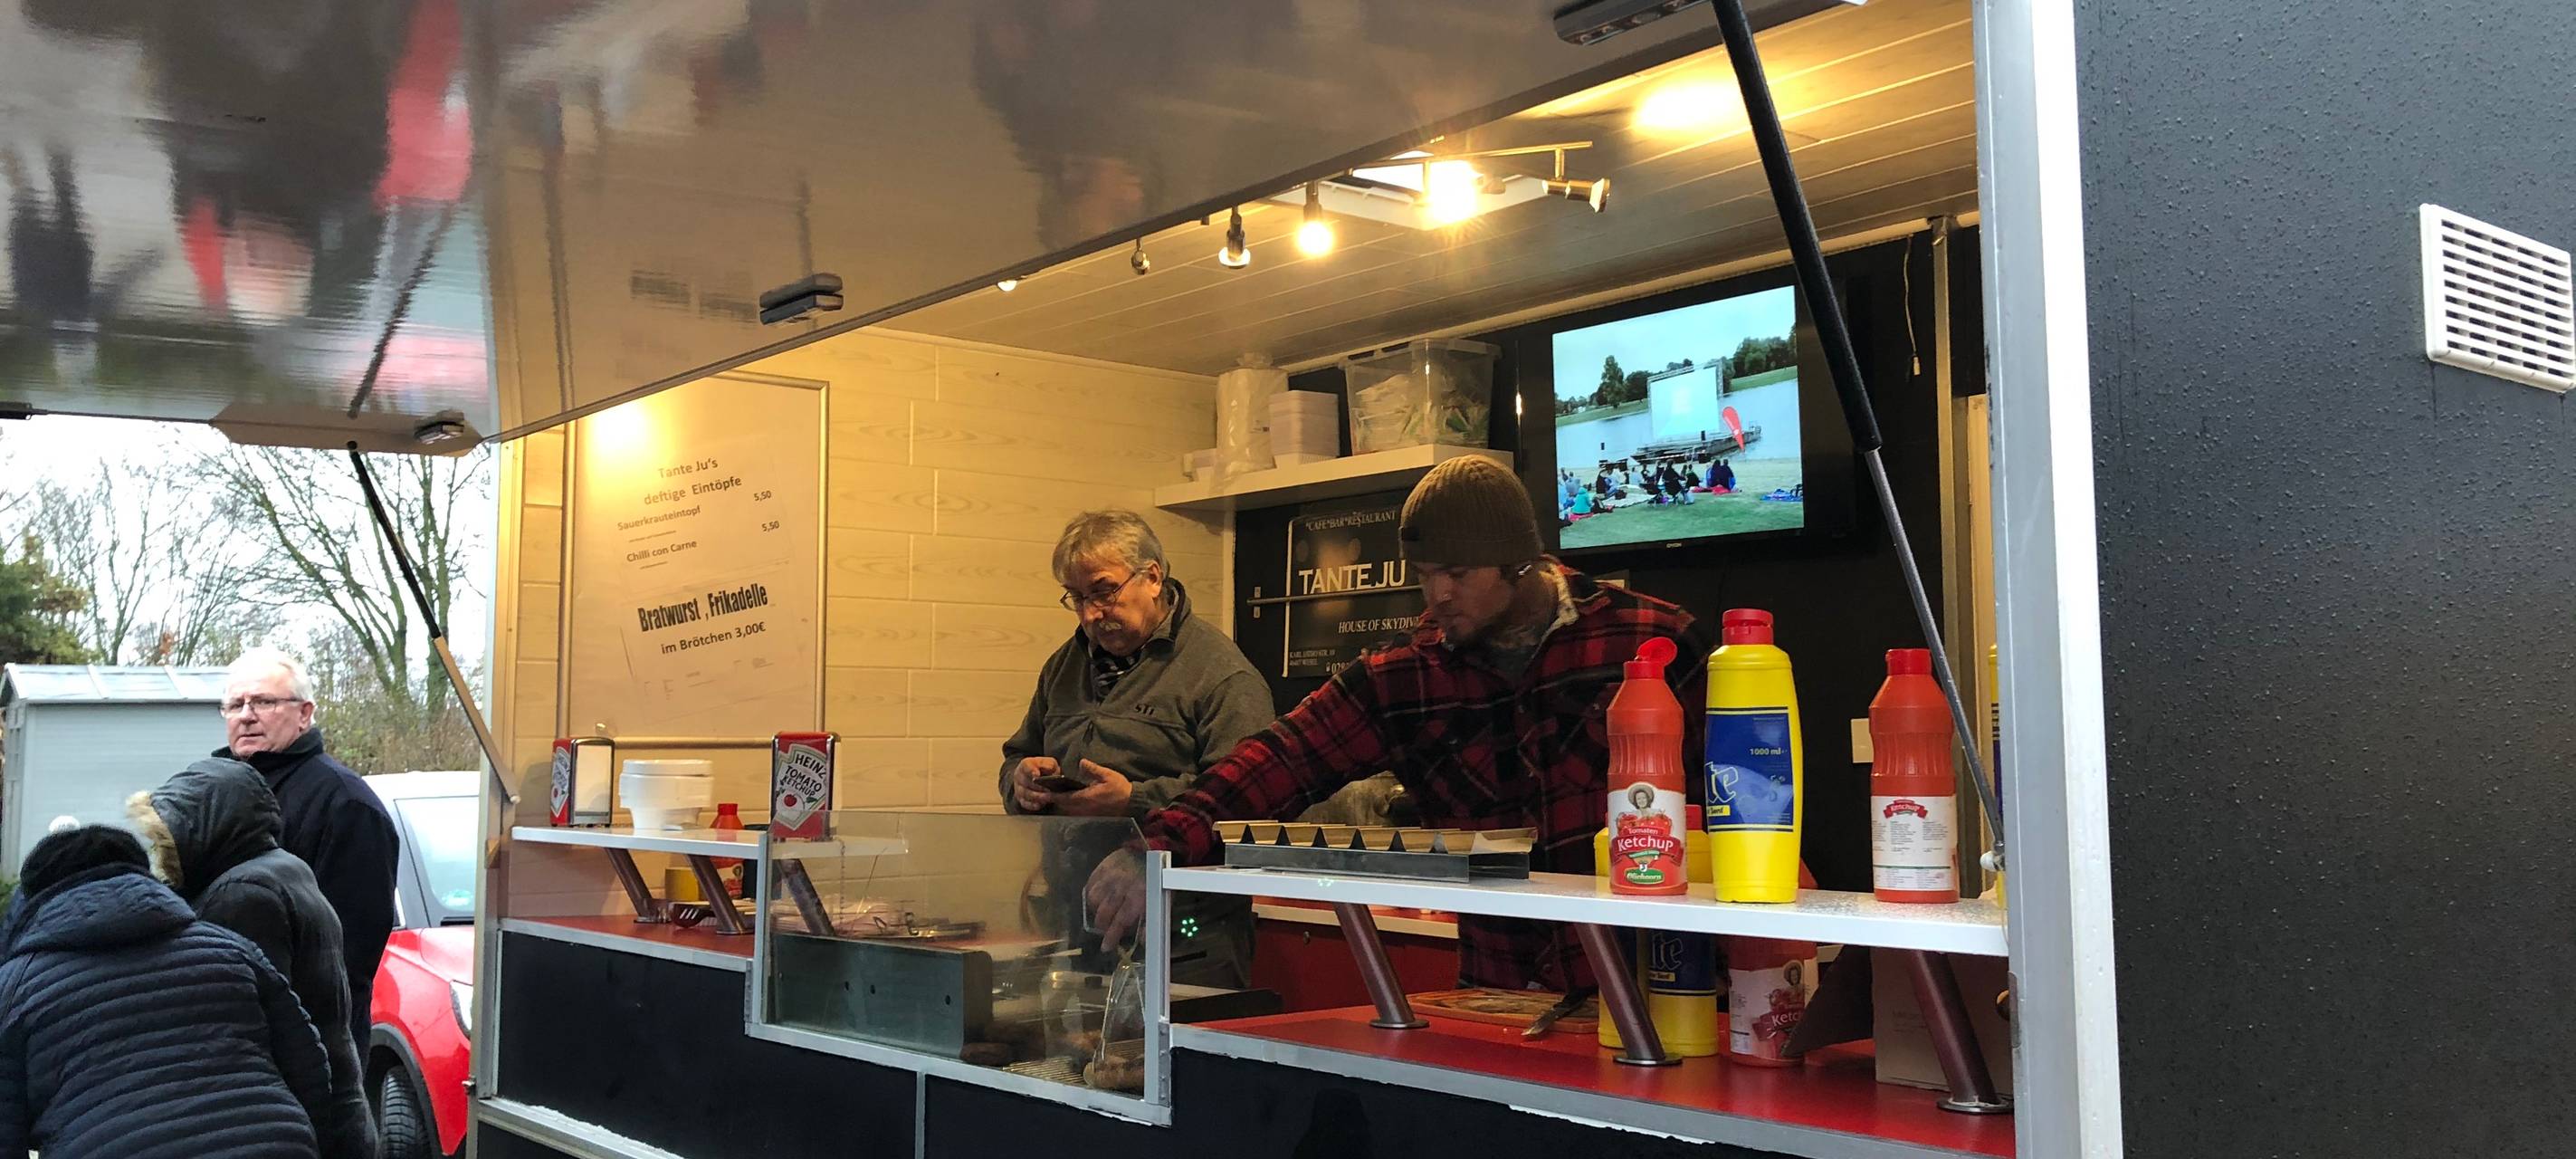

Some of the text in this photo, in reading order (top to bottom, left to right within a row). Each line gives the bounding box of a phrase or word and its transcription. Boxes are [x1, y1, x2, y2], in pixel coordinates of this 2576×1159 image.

[658, 464, 693, 479] Tante
[644, 475, 742, 505] deftige Eintöpfe
[753, 490, 772, 503] 5,50
[617, 504, 701, 532] Sauerkrauteintopf
[761, 520, 780, 532] 5,50
[626, 541, 698, 563] Chilli con Carne
[1298, 559, 1407, 595] TANTE JU
[637, 597, 701, 633] Bratwurst
[1338, 619, 1369, 634] HOUSE
[1368, 618, 1382, 631] OF
[661, 621, 767, 655] im Brötchen 3,00€
[1770, 746, 1781, 755] ml
[795, 753, 826, 780] HEINZ
[782, 776, 816, 797] KETCHUP
[785, 765, 822, 792] TOMATO
[1617, 835, 1674, 852] Ketchup
